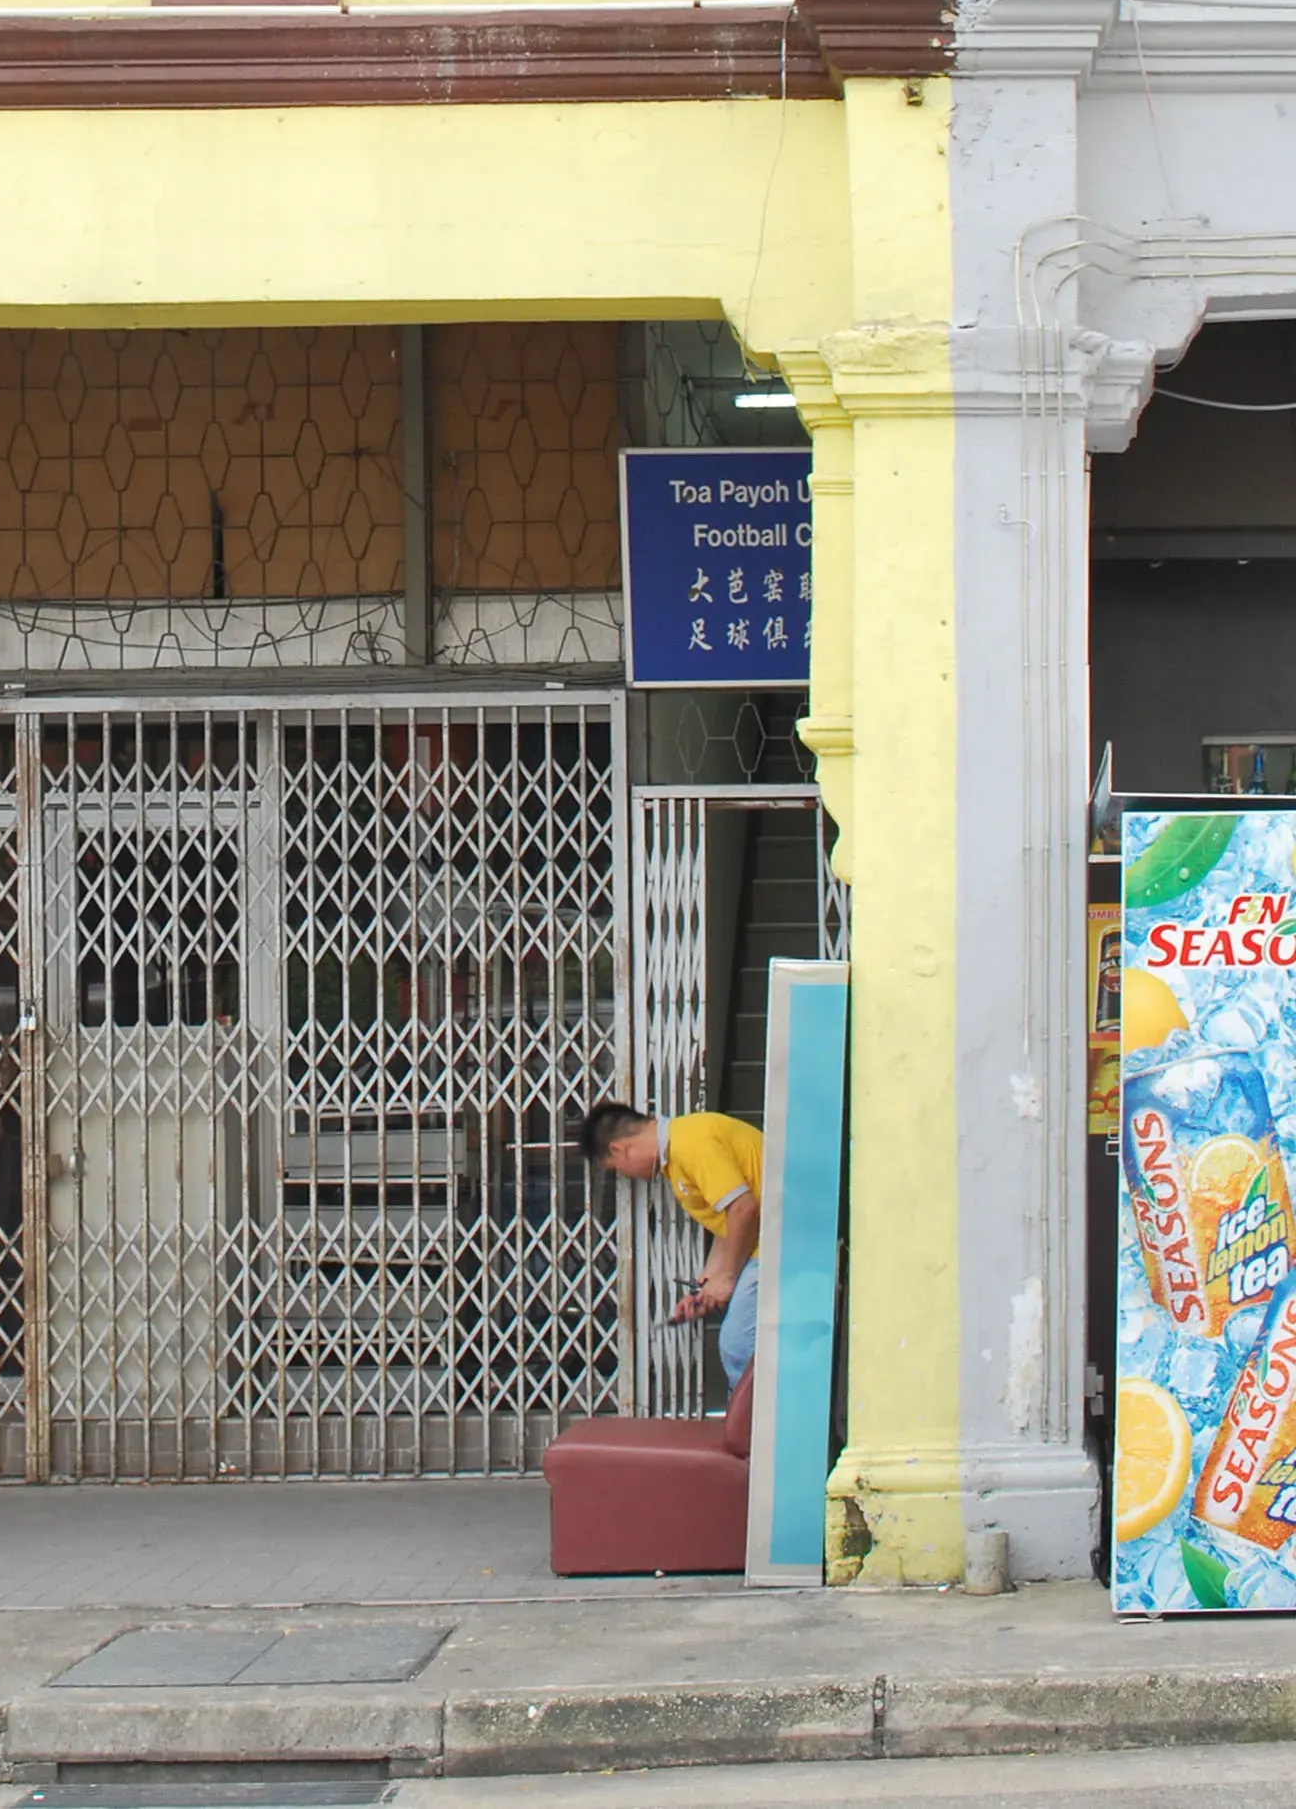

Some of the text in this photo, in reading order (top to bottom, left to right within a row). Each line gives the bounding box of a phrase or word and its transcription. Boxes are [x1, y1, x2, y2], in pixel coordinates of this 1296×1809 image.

[669, 480, 711, 503] Toa
[720, 480, 789, 508] Payoh
[694, 523, 787, 547] Football
[1227, 894, 1286, 925] F&N
[1133, 1112, 1205, 1323] SEASONS
[1217, 1195, 1267, 1251] ice
[1206, 1211, 1287, 1285] lemon
[1230, 1244, 1289, 1304] tea
